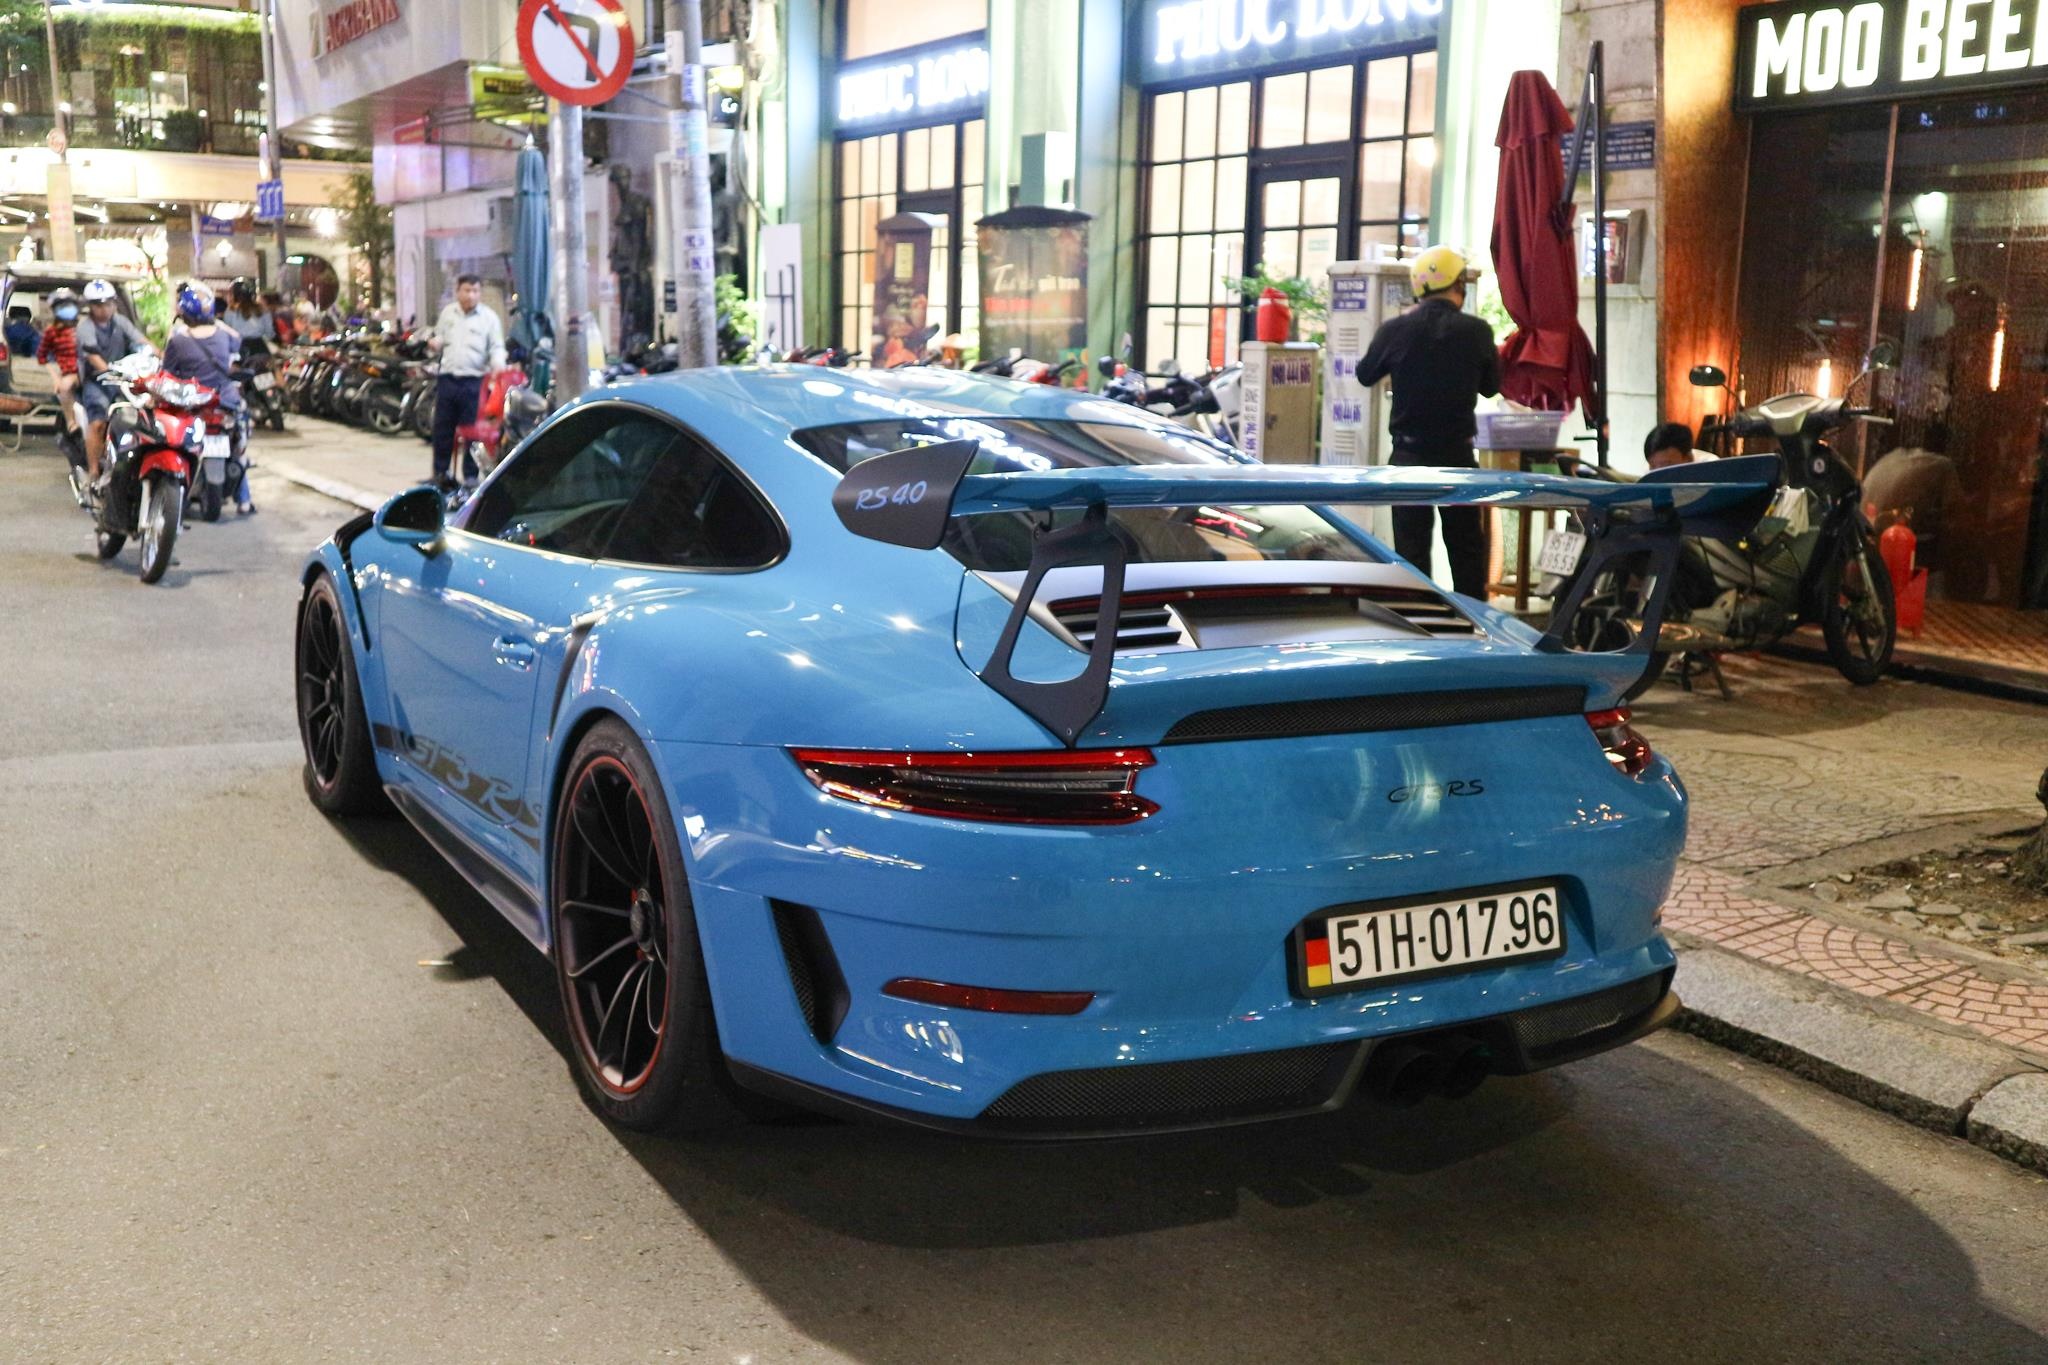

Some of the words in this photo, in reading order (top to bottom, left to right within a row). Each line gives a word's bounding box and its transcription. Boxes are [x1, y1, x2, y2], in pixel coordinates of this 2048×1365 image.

[1753, 2, 1884, 97] MOO
[856, 486, 889, 511] RS
[1447, 779, 1484, 797] RS
[1336, 892, 1555, 977] 51H-017.96
